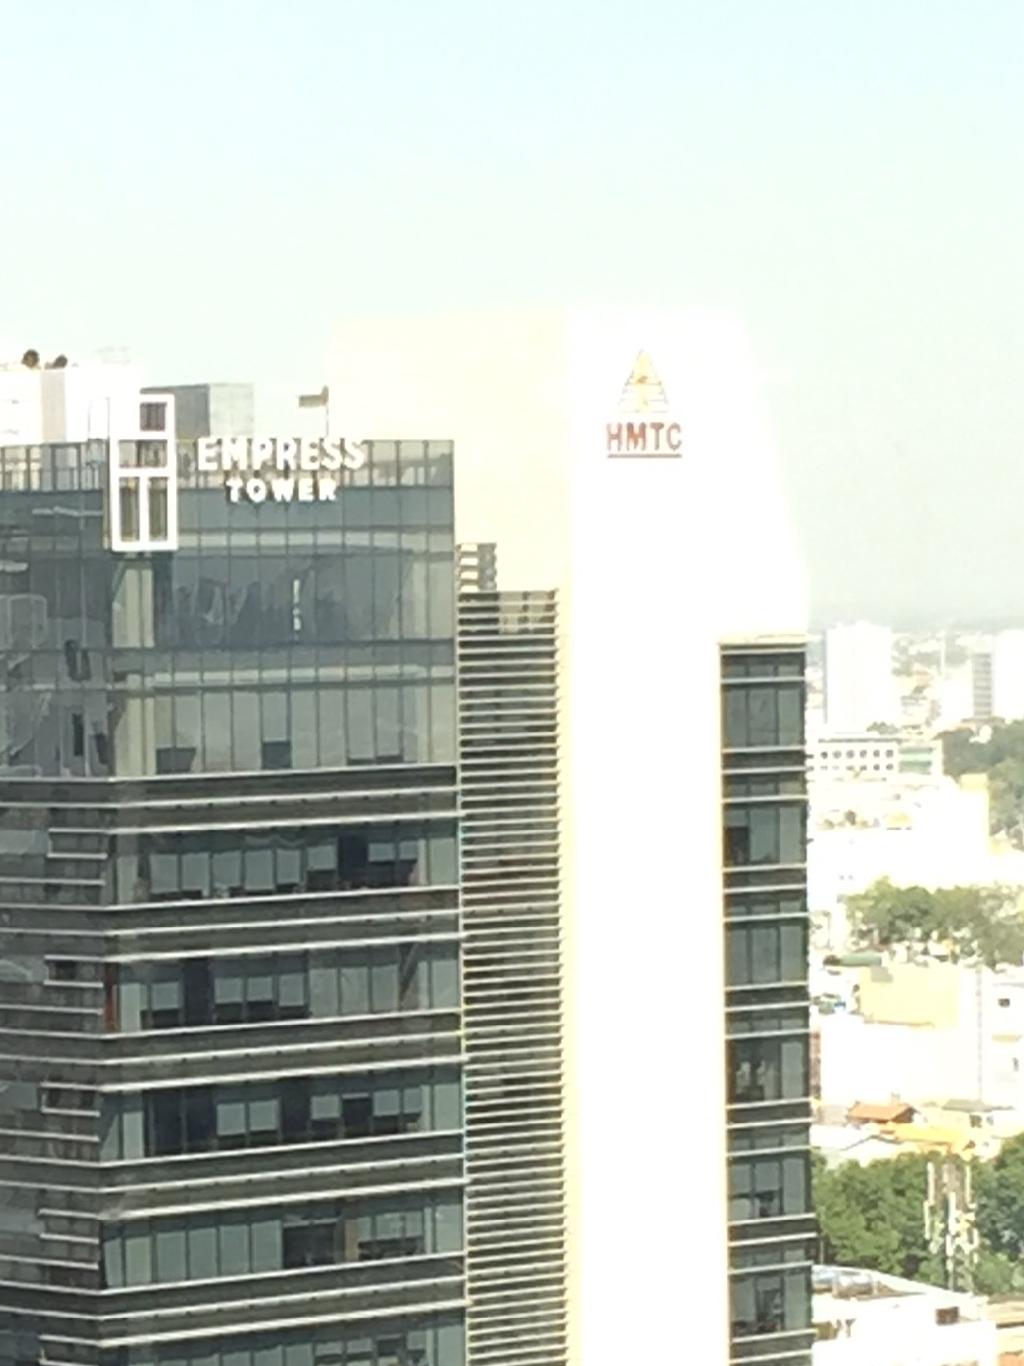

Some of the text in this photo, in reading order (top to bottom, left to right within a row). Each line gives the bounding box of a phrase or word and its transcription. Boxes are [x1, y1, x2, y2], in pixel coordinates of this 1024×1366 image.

[606, 421, 682, 451] HMTC
[197, 436, 365, 471] EMPRESS
[226, 476, 337, 503] TOWER
